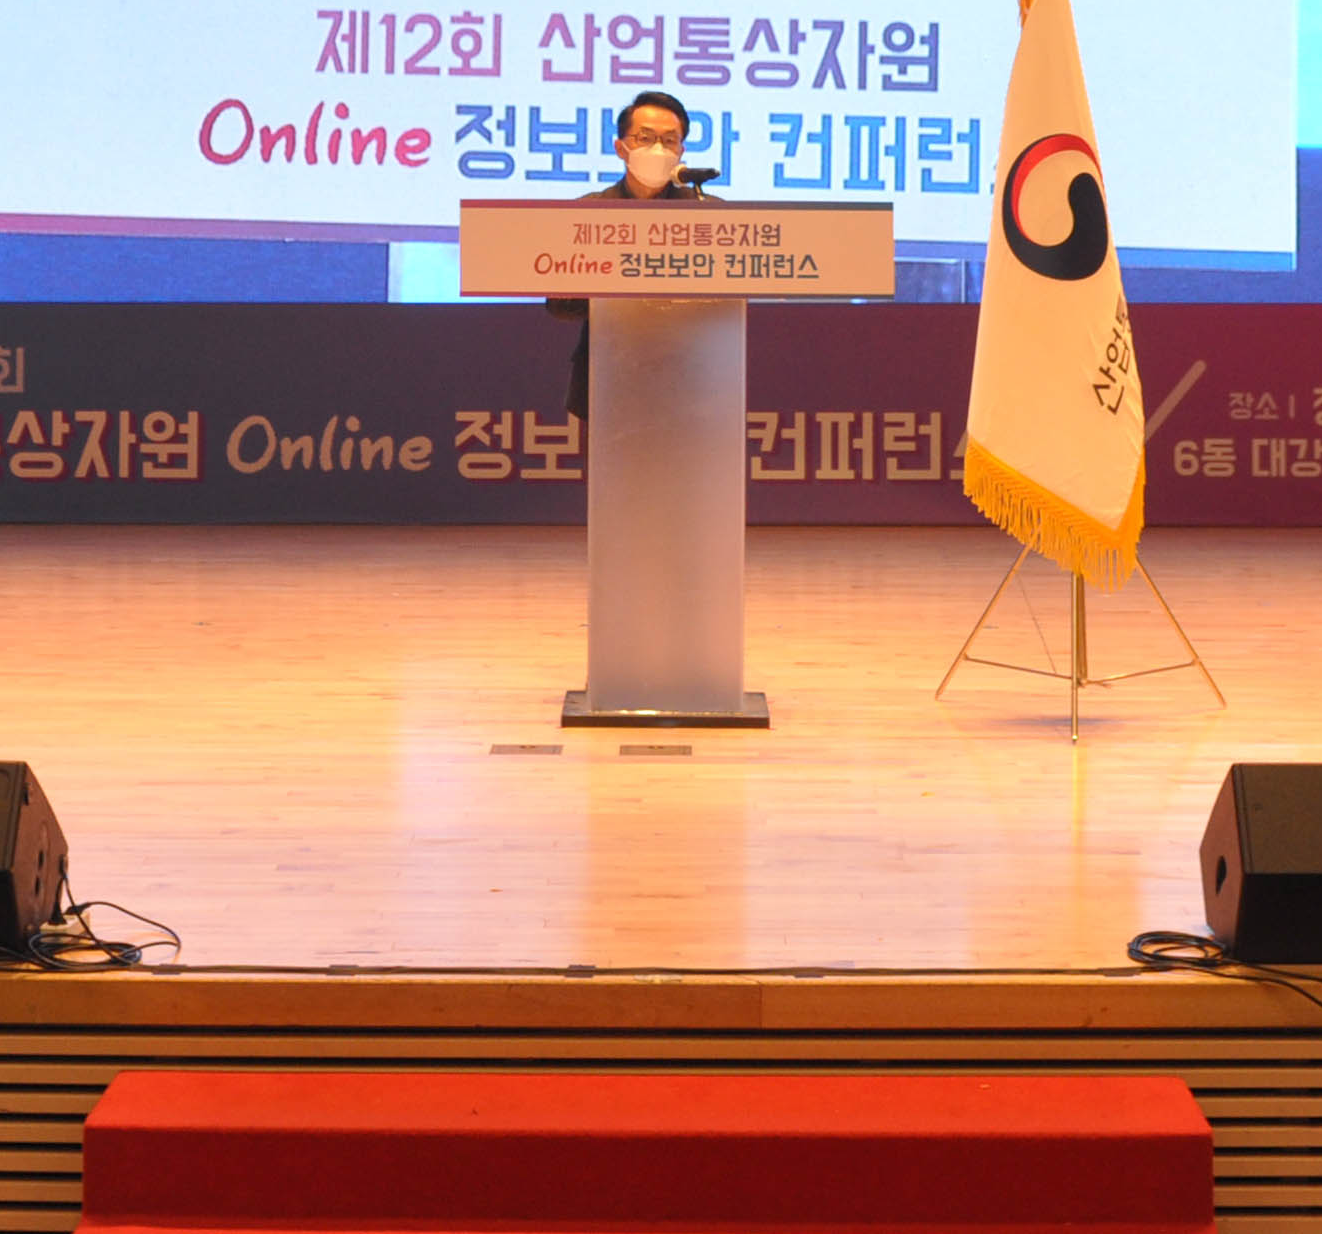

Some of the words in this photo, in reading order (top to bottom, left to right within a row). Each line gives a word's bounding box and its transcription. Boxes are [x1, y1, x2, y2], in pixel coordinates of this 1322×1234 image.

[315, 10, 503, 77] 제12회
[538, 13, 940, 92] 산업통상자원
[199, 98, 432, 168] Online
[769, 113, 989, 195] 컨퍼런
[573, 223, 636, 246] 제12회
[648, 223, 781, 247] 산업통상자원
[534, 253, 613, 275] Online
[619, 253, 715, 278] 정보보안
[725, 253, 820, 279] 컨퍼런스
[1229, 393, 1279, 419] 장소
[227, 414, 432, 472] Online
[747, 410, 966, 481] 컨퍼런
[1174, 438, 1236, 478] 6동
